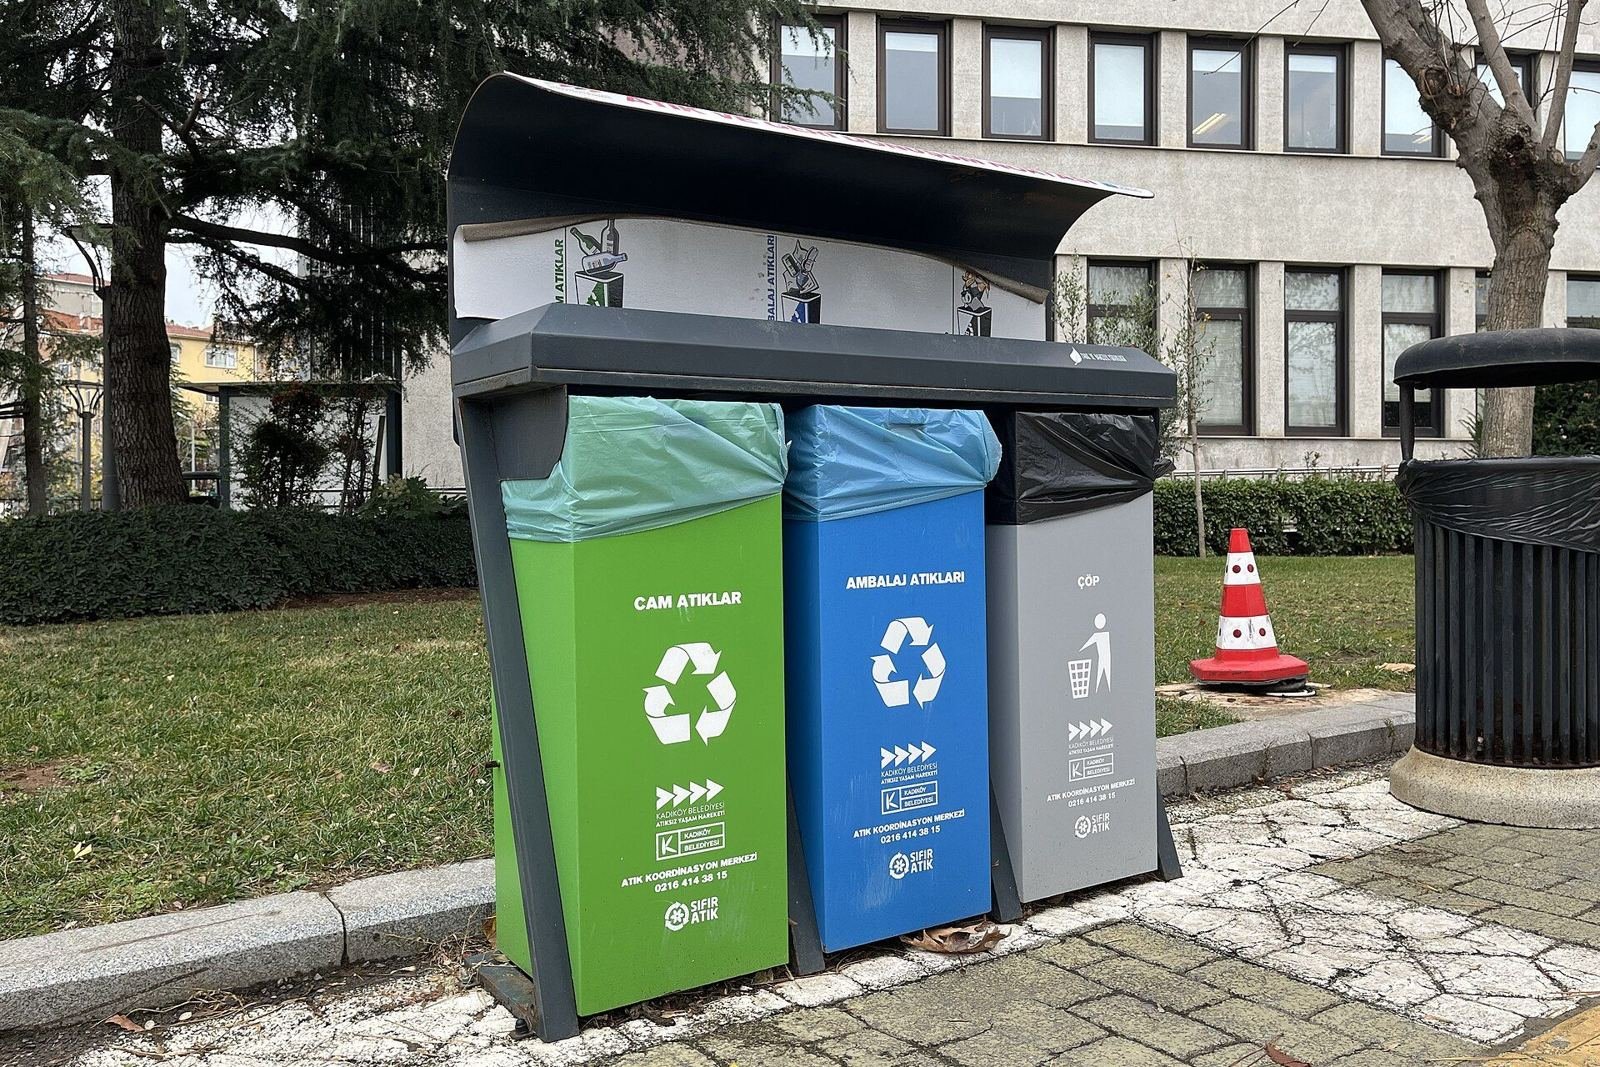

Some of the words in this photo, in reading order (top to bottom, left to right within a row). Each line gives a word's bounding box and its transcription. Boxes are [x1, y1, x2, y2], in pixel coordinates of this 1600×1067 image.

[555, 240, 564, 292] ATIKLAR
[846, 574, 907, 589] AMBALAJ
[910, 571, 965, 586] ATIKLARI
[1078, 574, 1100, 589] ÇÖP
[634, 595, 672, 610] CAM
[676, 592, 742, 608] ATIKLAR
[1047, 793, 1061, 801] ATIK
[1068, 798, 1084, 807] 0216
[853, 828, 871, 838] ATIK
[873, 816, 932, 834] KOORDİNASYON
[934, 808, 965, 822] MERKEZİ
[1092, 812, 1110, 824] SIFIR
[881, 833, 900, 844] 0216
[902, 830, 917, 839] 414
[919, 827, 928, 836] 38
[931, 825, 940, 833] 15
[1092, 822, 1110, 833] ATIK
[661, 835, 678, 855] K
[910, 848, 933, 862] SIFIR
[621, 876, 643, 887] ATIK
[646, 860, 718, 881] KOORDİNASYON
[720, 852, 757, 867] MERKEZİ
[910, 859, 933, 873] ATIK
[655, 881, 679, 893] 0216
[682, 877, 699, 887] 414
[702, 873, 714, 883] 38
[716, 871, 728, 880] 15
[690, 897, 718, 912] SIFIR
[691, 908, 718, 924] ATIK
